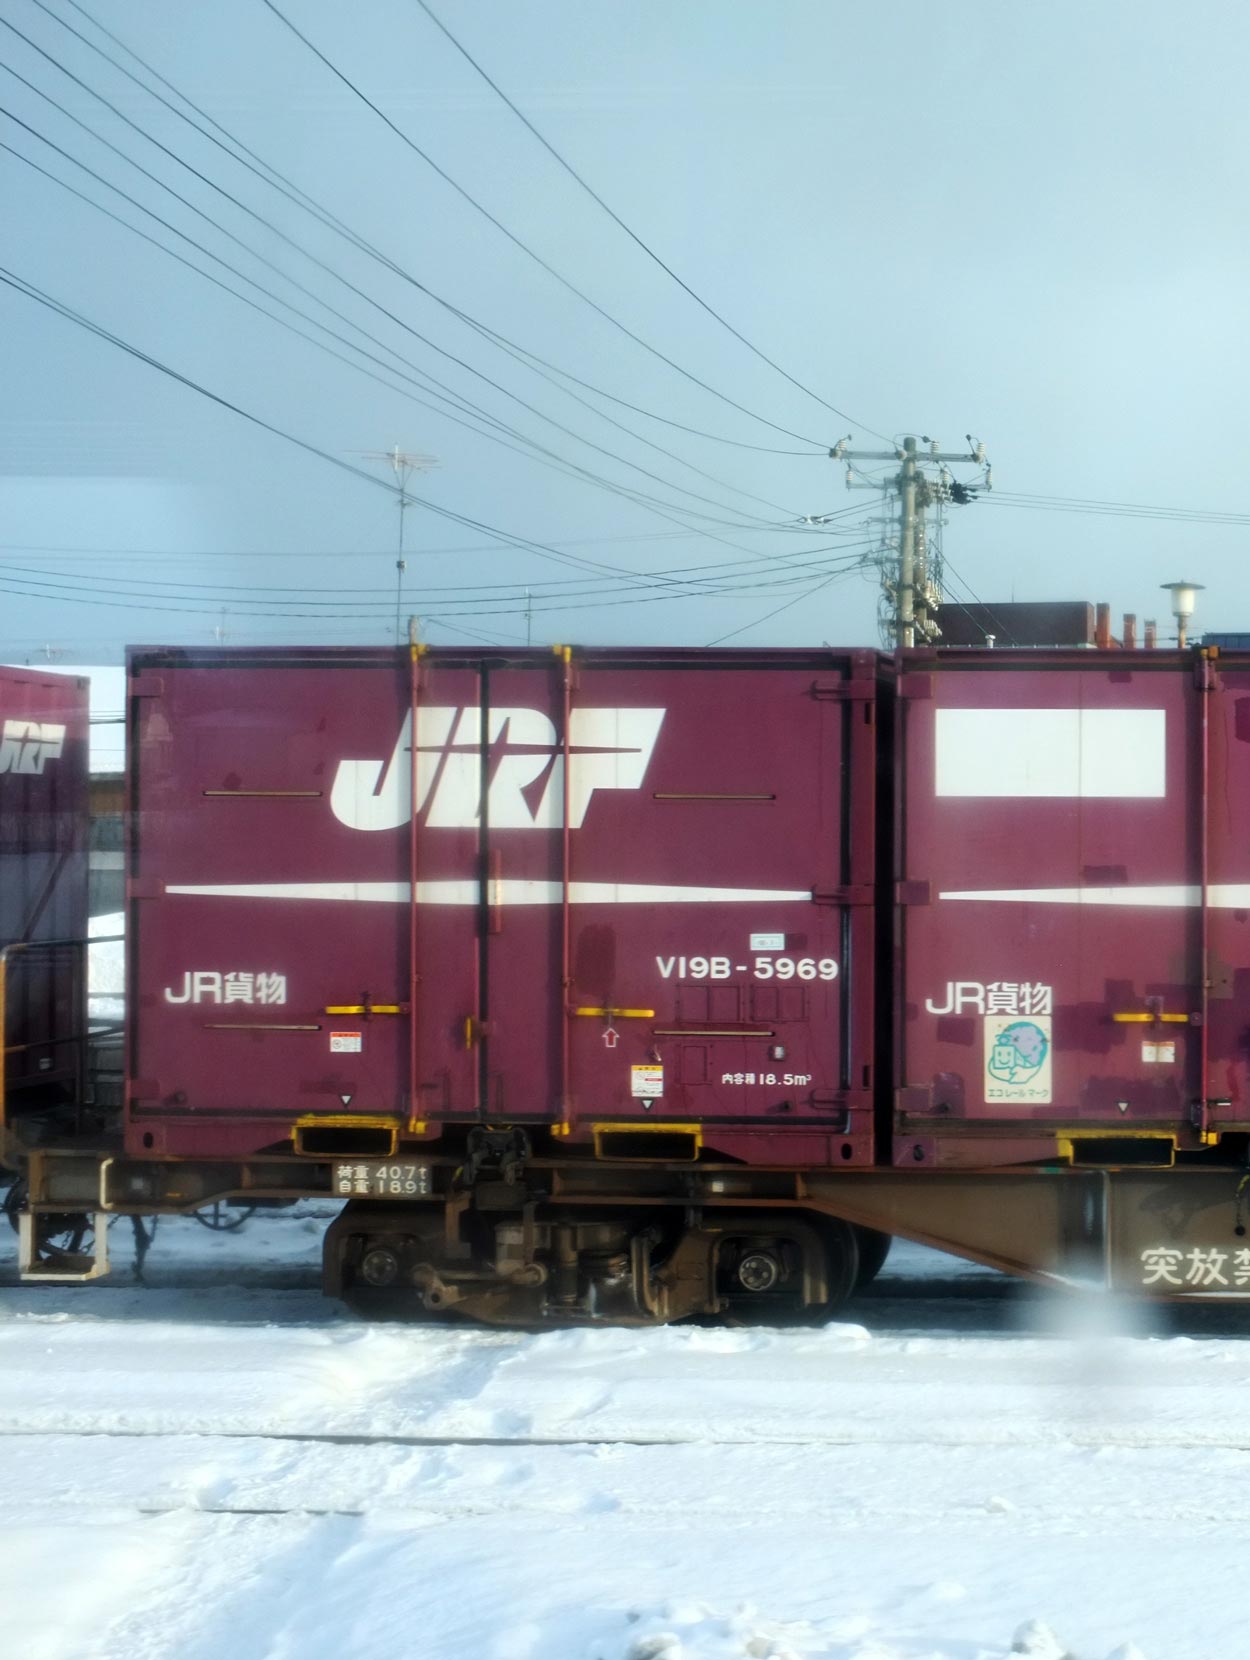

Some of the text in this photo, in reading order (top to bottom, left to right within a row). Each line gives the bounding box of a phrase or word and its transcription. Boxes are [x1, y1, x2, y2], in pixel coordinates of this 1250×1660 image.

[330, 707, 667, 831] JRF
[165, 972, 287, 1004] JR貨物
[925, 982, 1052, 1015] JR貨物
